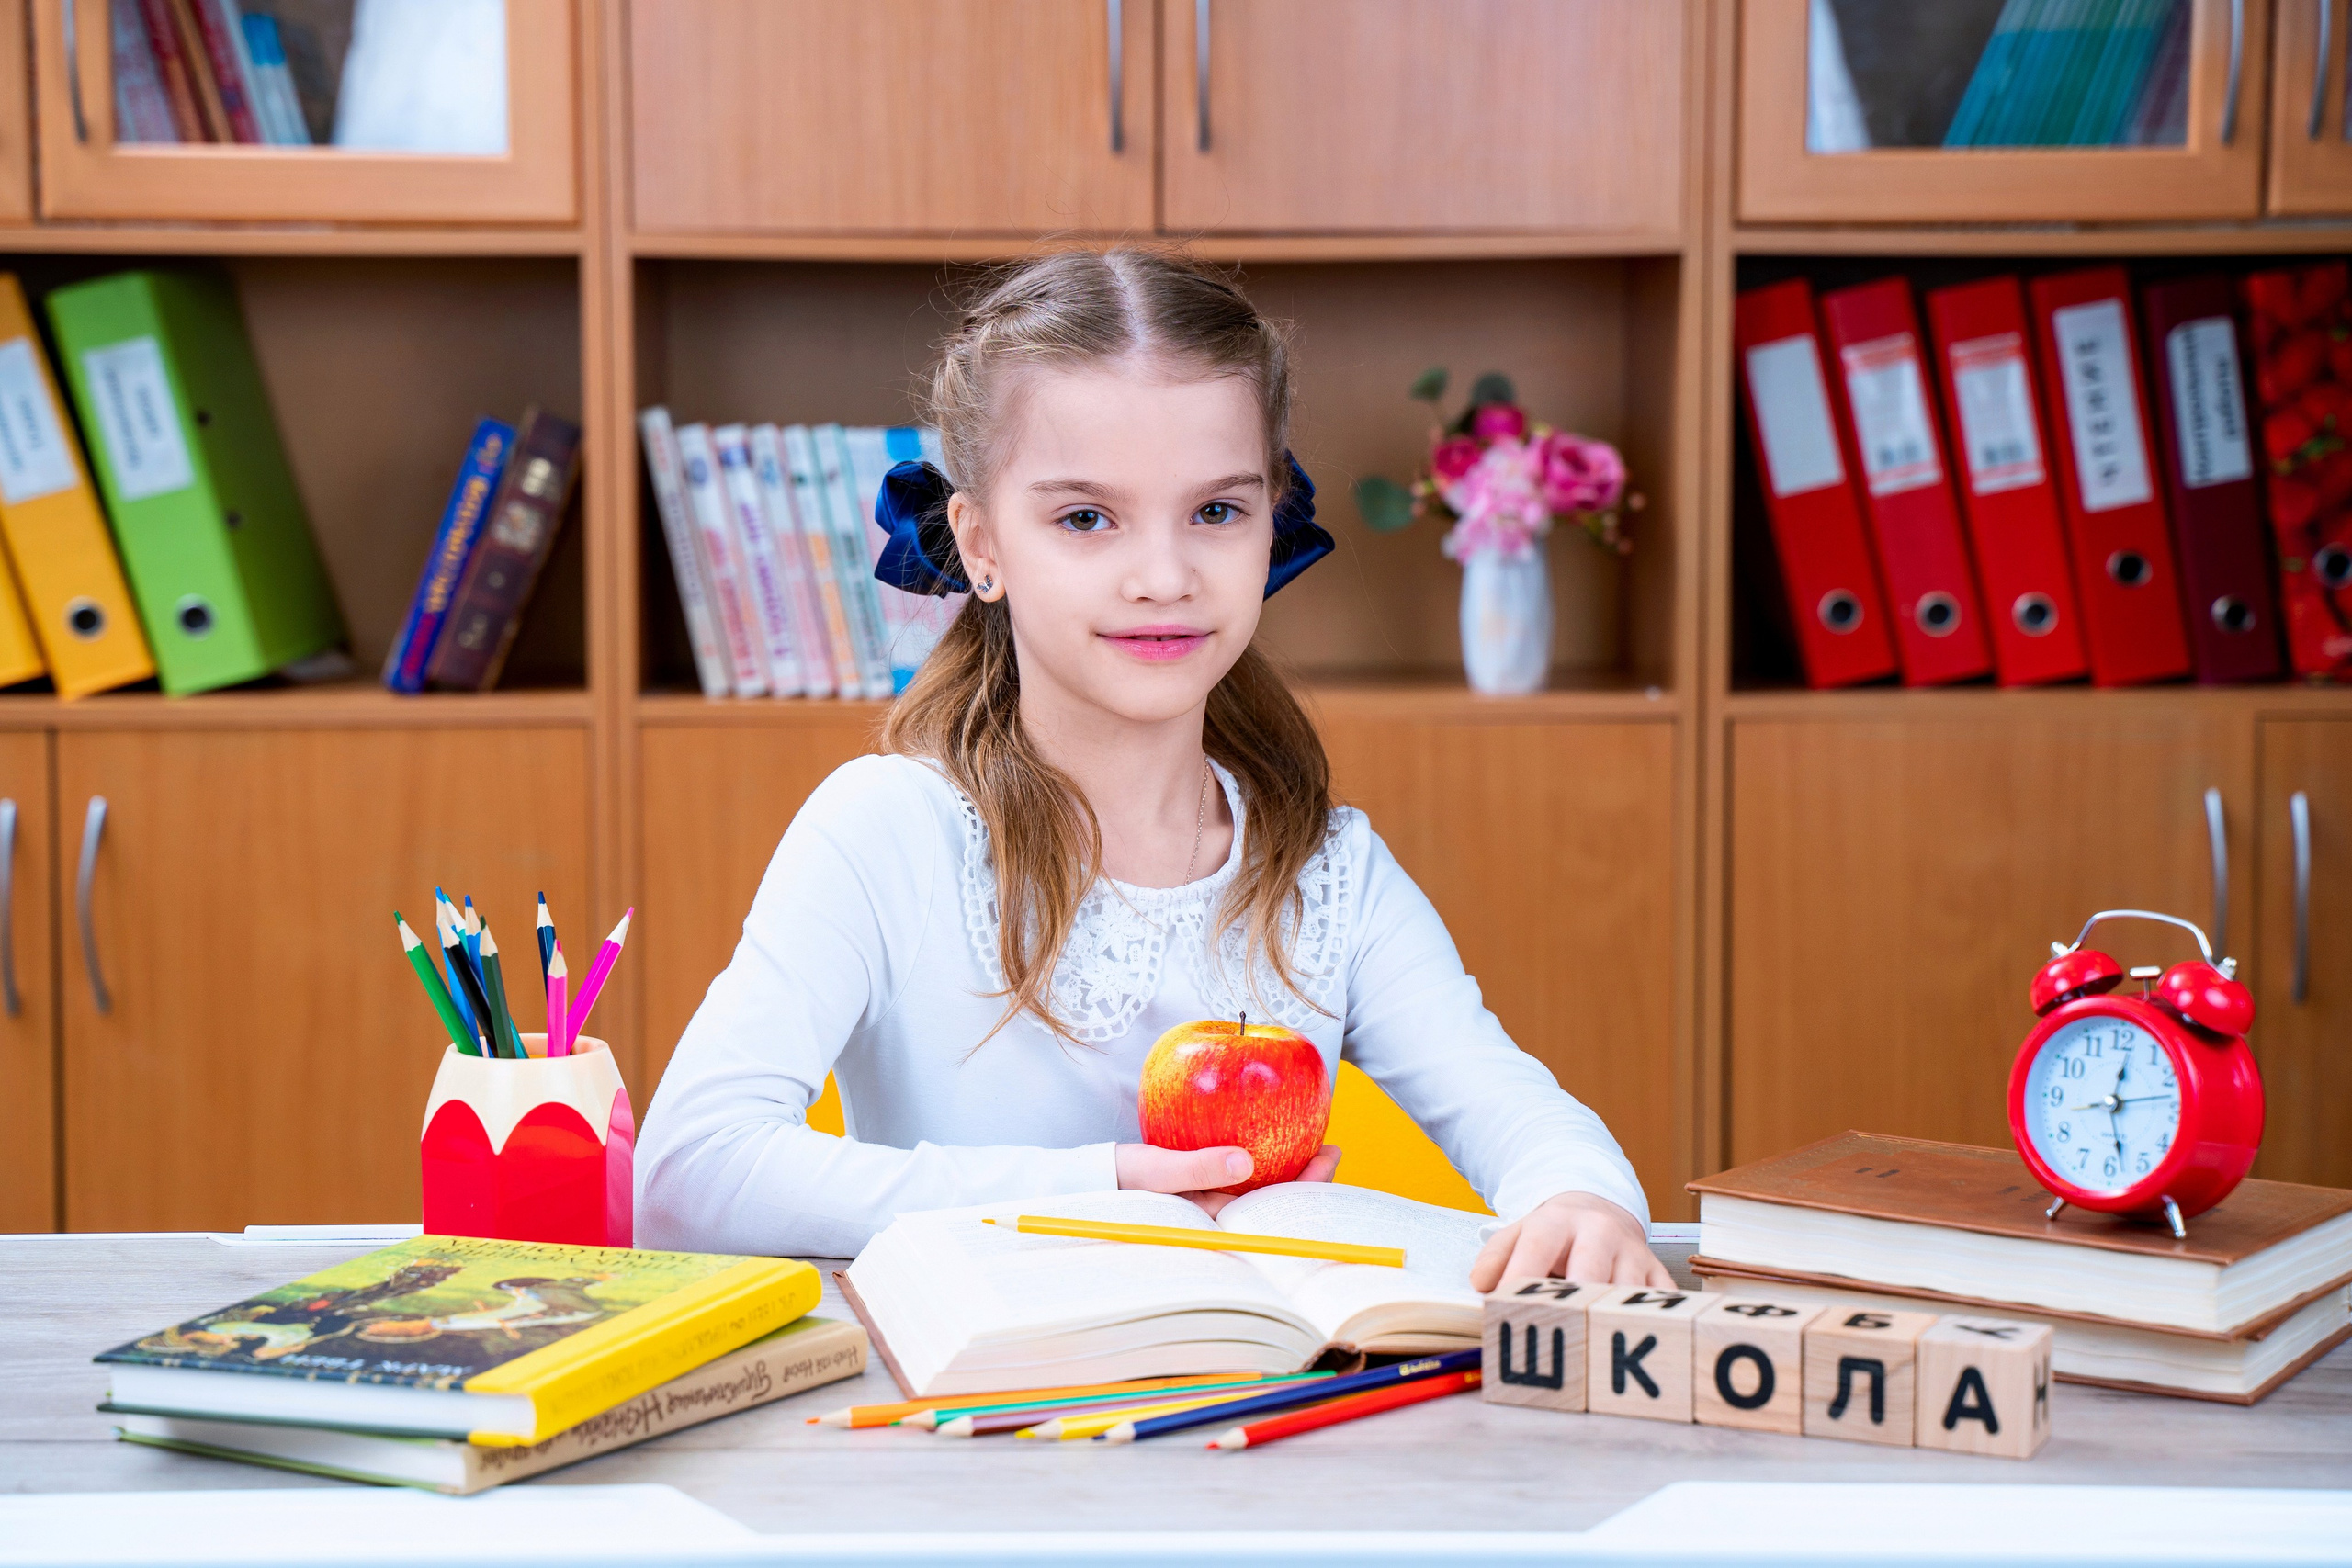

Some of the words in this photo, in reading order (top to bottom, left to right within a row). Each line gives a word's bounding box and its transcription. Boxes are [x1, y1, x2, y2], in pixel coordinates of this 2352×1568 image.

[2083, 1035, 2103, 1057] 11
[2109, 1029, 2135, 1052] 12
[2148, 1044, 2160, 1066] 1
[2060, 1056, 2086, 1079] 10
[2162, 1066, 2176, 1088] 2
[2050, 1086, 2064, 1107] 9
[2056, 1122, 2072, 1144] 8
[2155, 1133, 2169, 1154] 4
[2076, 1148, 2091, 1169] 7
[2103, 1156, 2118, 1177] 6
[2135, 1152, 2150, 1173] 5
